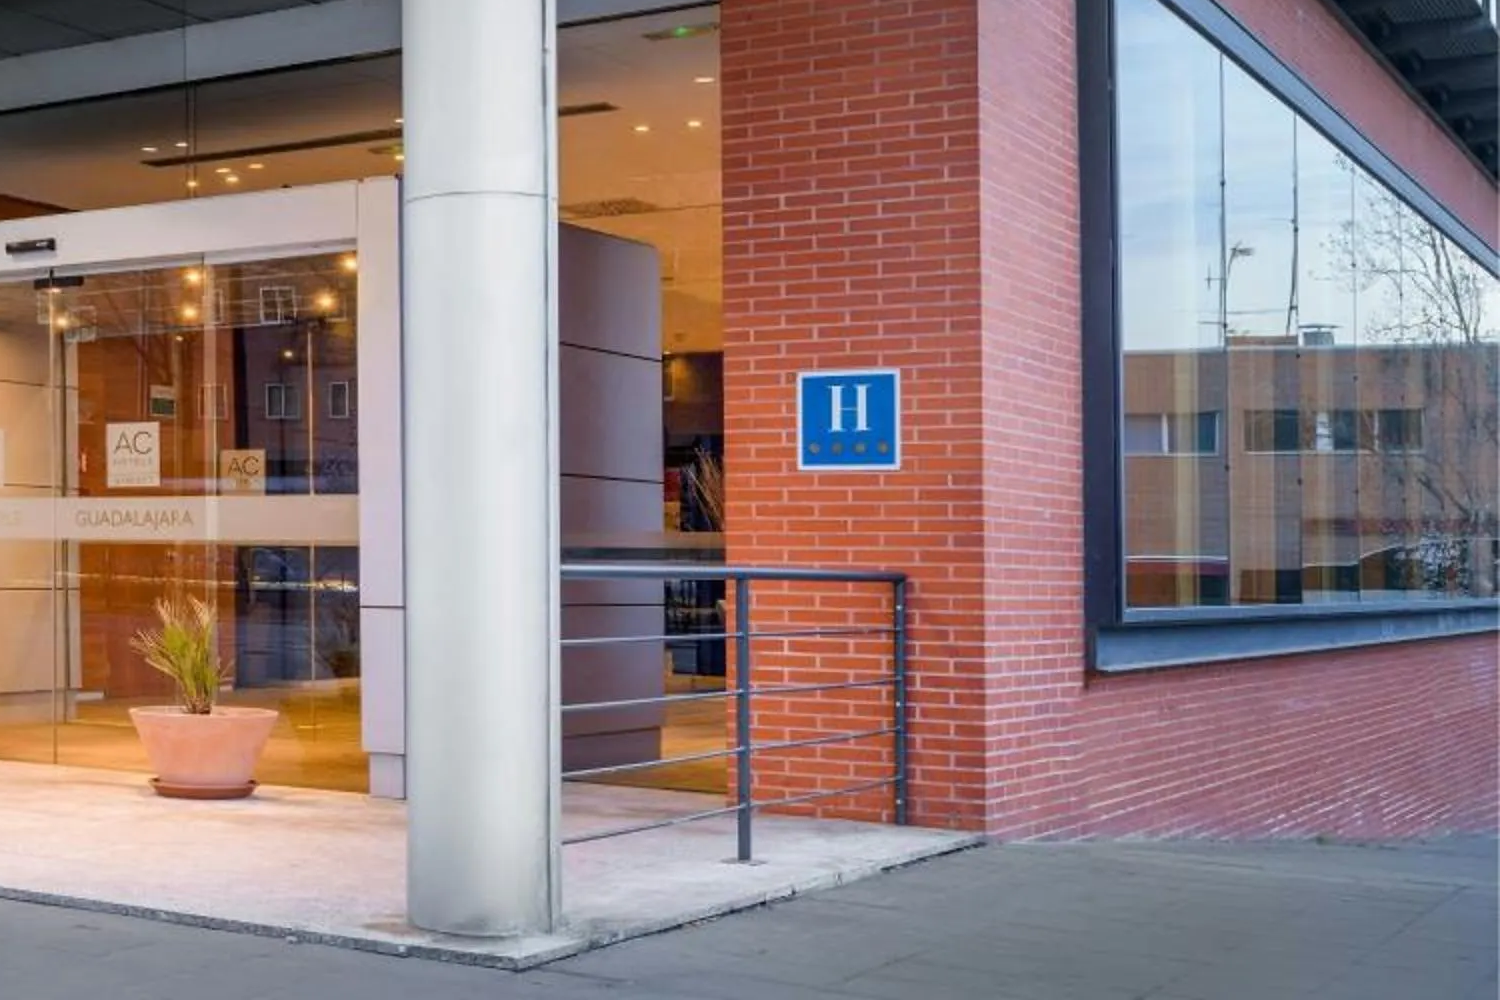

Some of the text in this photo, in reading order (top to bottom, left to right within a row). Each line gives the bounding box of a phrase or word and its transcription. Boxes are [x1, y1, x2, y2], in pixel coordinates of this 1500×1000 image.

[826, 383, 873, 433] H
[113, 430, 153, 455] AC
[227, 455, 260, 477] AC
[75, 508, 194, 531] GUADALAJARA
